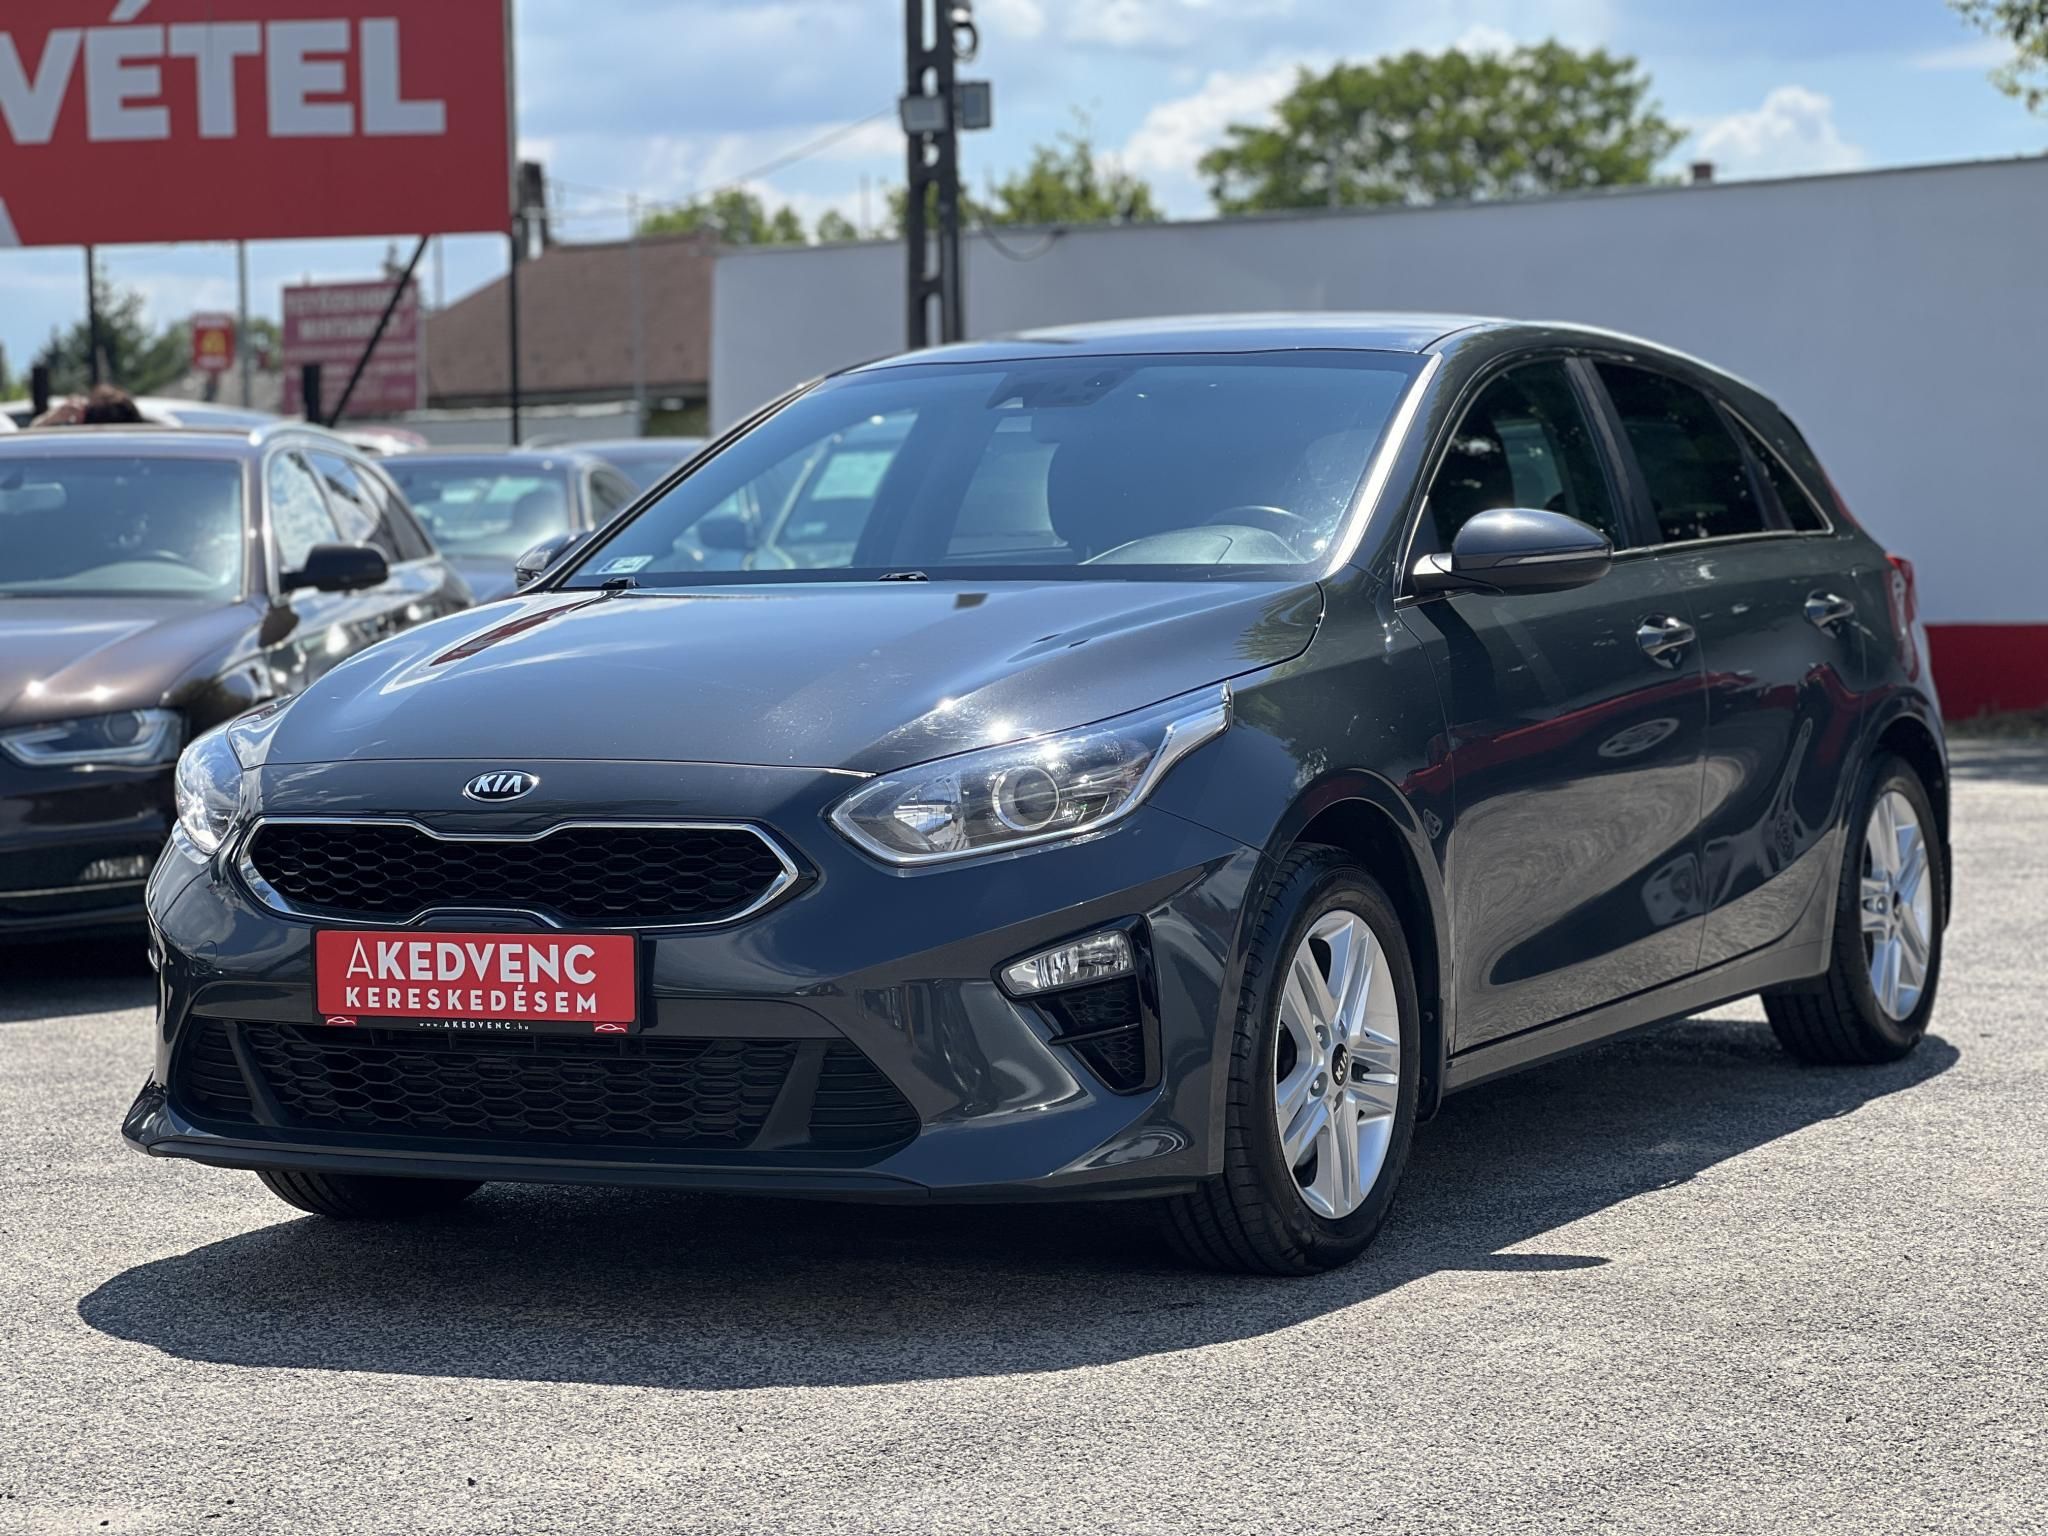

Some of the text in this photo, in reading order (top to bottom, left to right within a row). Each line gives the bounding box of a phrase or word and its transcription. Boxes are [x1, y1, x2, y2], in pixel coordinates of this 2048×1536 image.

[473, 774, 523, 793] KIA
[345, 984, 597, 1014] KERESKEDÉSEM
[419, 1020, 529, 1031] www.AKEDVENC.hu
[1335, 1050, 1348, 1081] KIA
